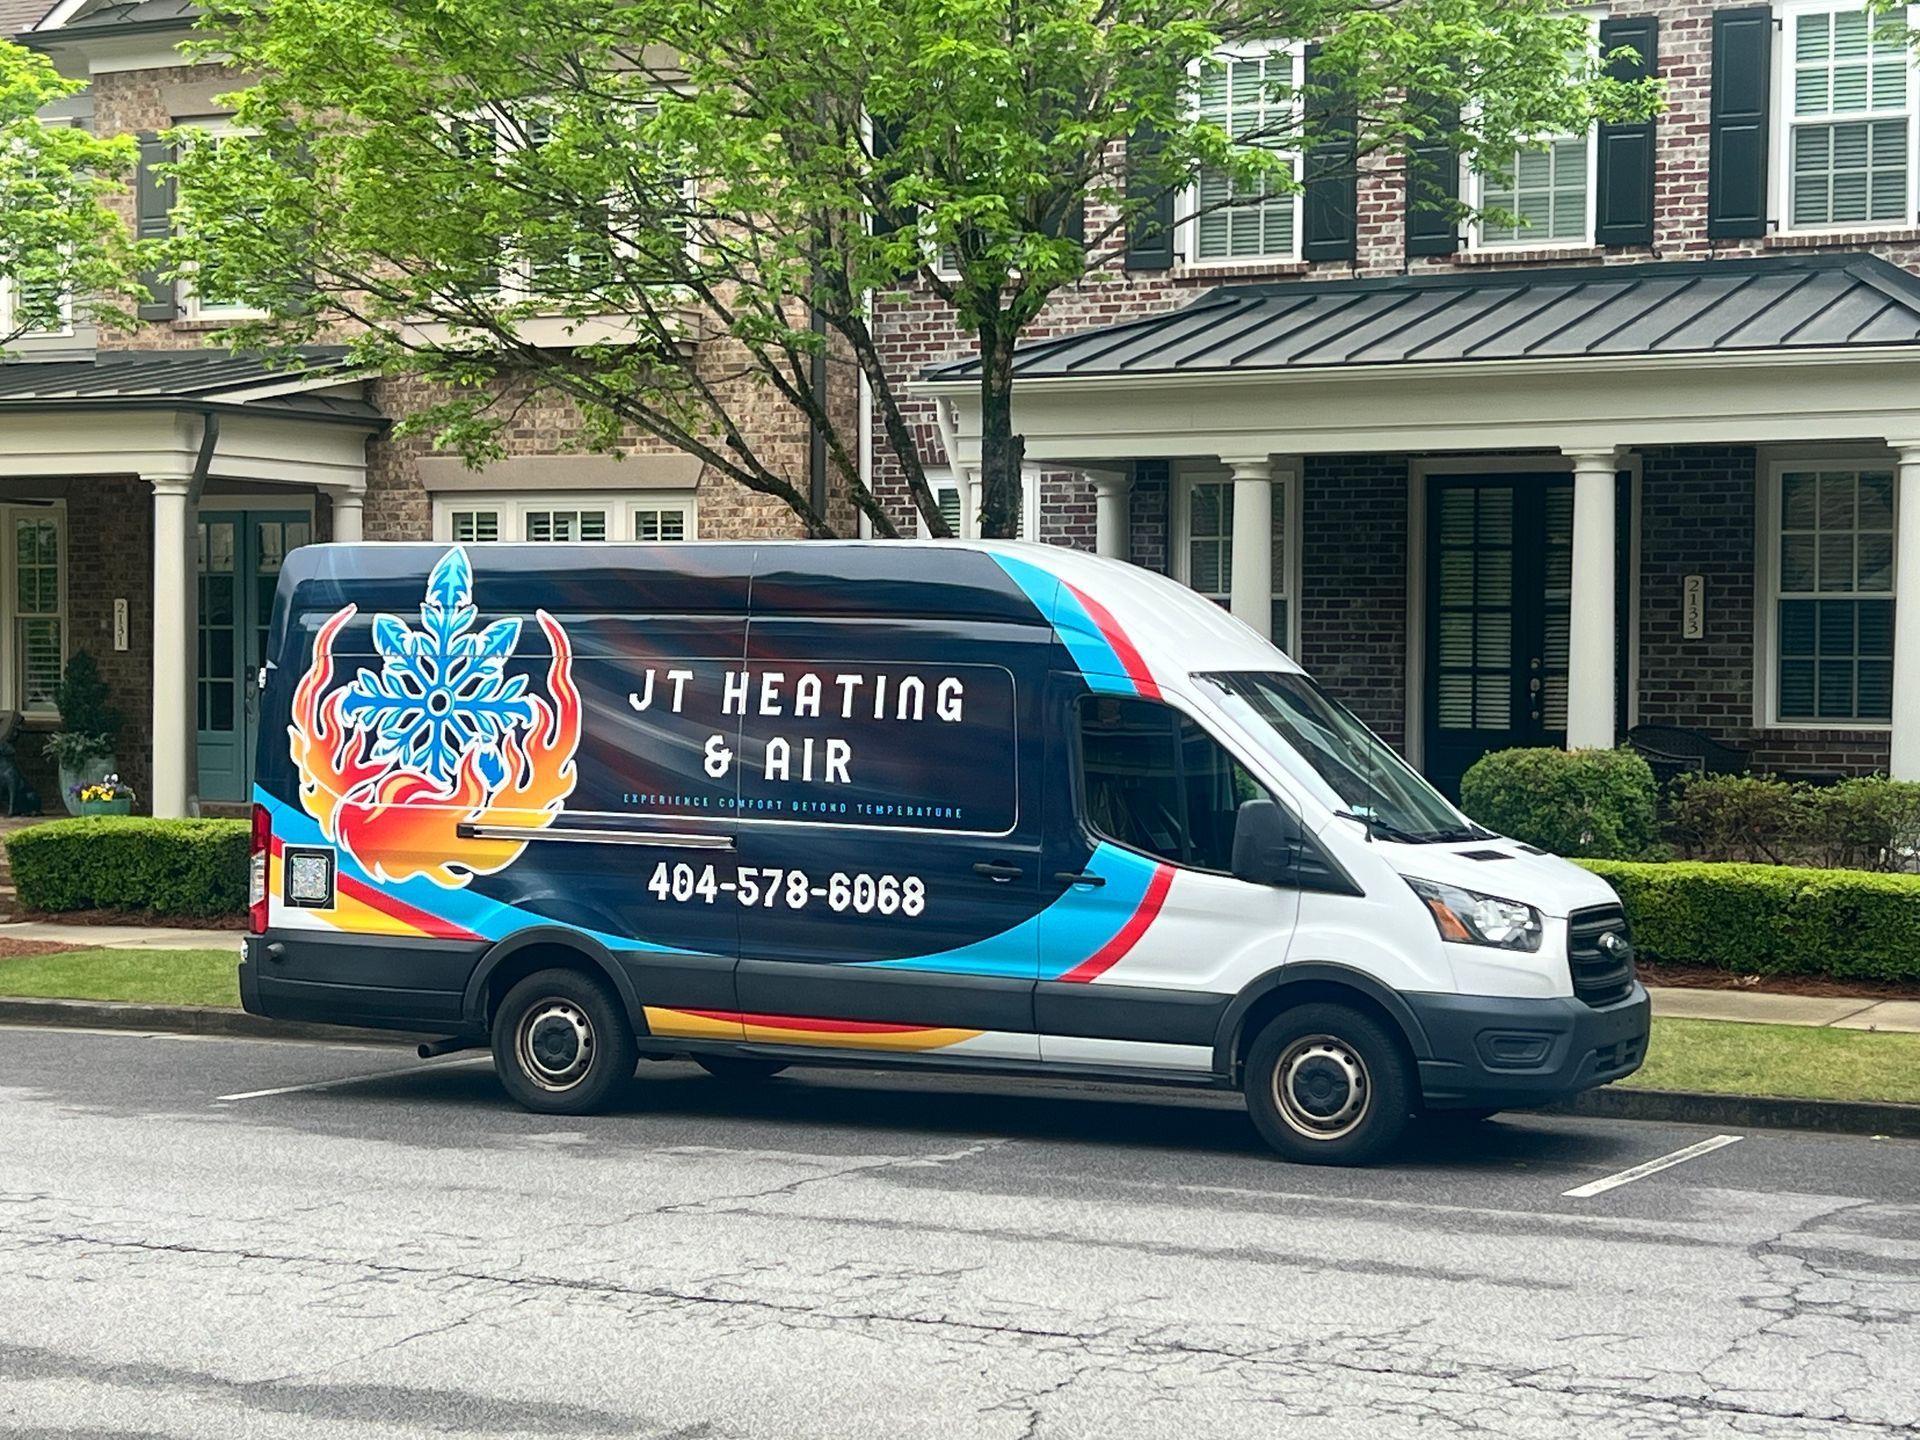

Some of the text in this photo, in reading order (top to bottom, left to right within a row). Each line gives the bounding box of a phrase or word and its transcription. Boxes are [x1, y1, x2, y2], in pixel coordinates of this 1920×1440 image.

[1687, 579, 1700, 635] 2133
[628, 669, 964, 722] JT HEATING
[704, 735, 852, 784] & AIR
[623, 793, 962, 819] EXPERIENCE COMFORT BEYOND TEMPERATURE
[648, 861, 926, 917] 404-578-6068
